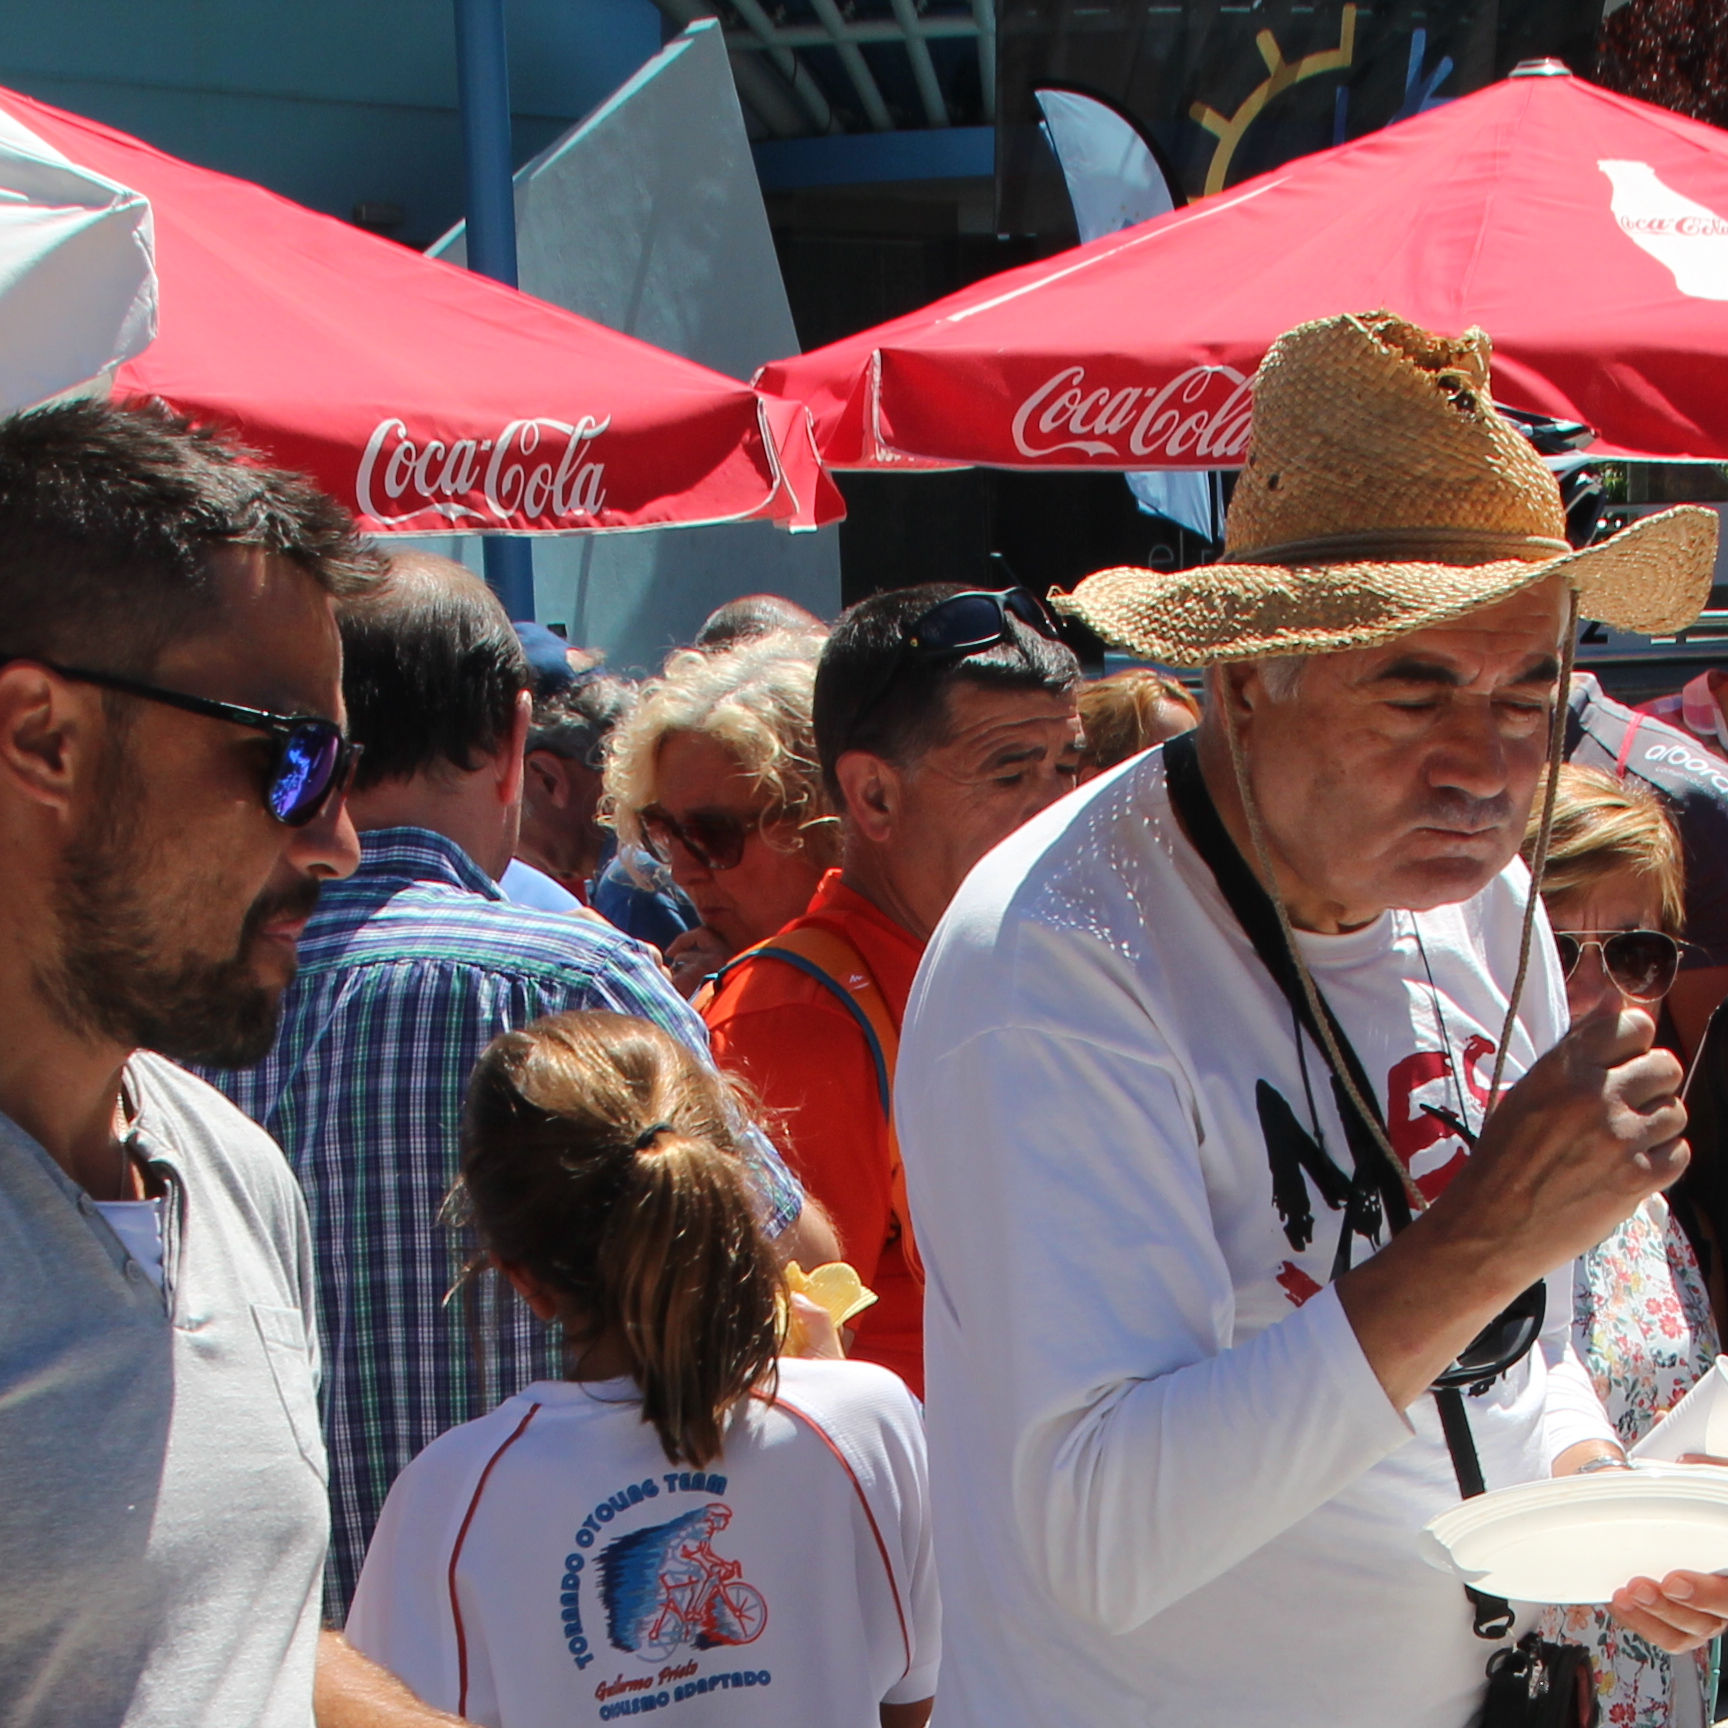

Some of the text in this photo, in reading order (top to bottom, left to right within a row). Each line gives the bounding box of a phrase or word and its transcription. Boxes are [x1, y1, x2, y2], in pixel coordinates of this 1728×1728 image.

[356, 413, 612, 526] Coca-Cola
[663, 1472, 728, 1497] TEAM
[674, 1669, 772, 1704] ADAPTADO
